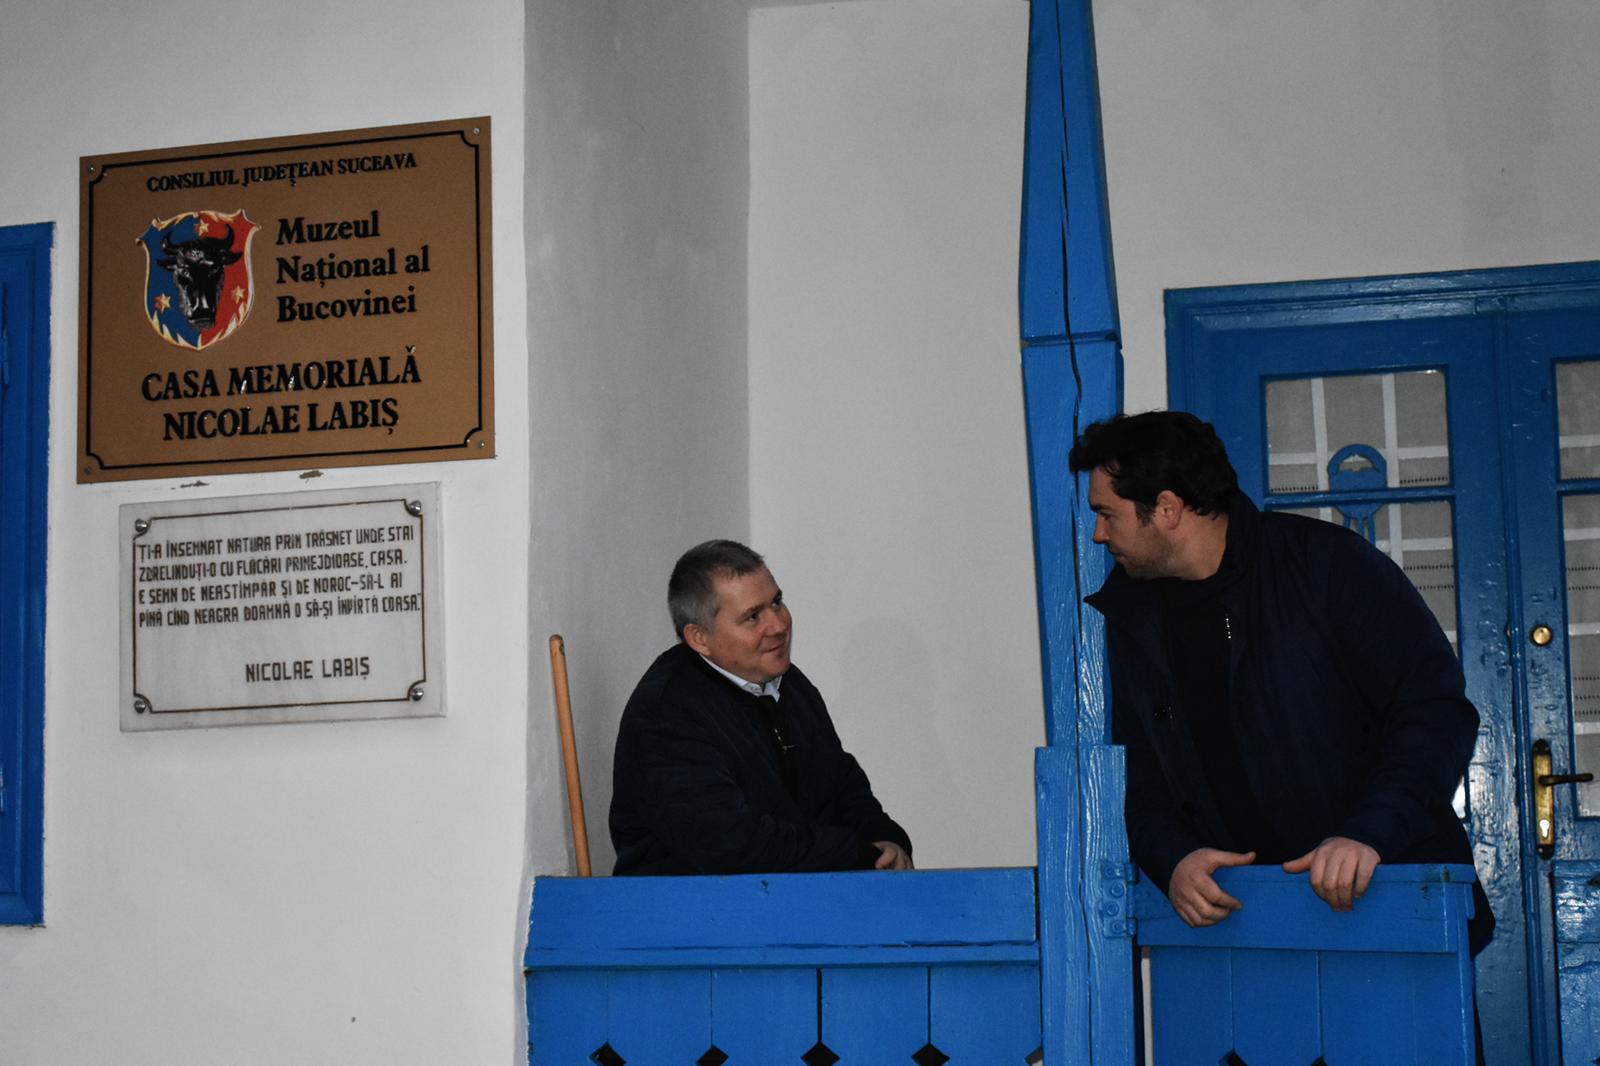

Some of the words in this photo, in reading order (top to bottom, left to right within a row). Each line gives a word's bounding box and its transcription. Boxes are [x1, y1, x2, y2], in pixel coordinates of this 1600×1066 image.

[147, 170, 239, 192] CONSILIUL
[242, 160, 334, 187] JUDEȚEAN
[337, 152, 416, 175] SUCEAVA
[275, 210, 380, 246] Muzeul
[275, 248, 397, 287] Național
[406, 245, 430, 274] al
[276, 286, 417, 323] Bucovinei
[141, 368, 219, 402] CASA
[227, 345, 421, 395] MEMORIALĂ
[163, 405, 300, 442] NICOLAE
[307, 398, 399, 436] LABIȘ
[227, 535, 271, 554] NATURA
[356, 527, 385, 544] UNDE
[388, 525, 414, 542] STAI
[220, 561, 234, 577] CU
[138, 589, 145, 605] E
[149, 587, 178, 605] SEMN
[181, 586, 196, 602] DE
[296, 578, 310, 595] DE
[390, 571, 403, 589] AI
[194, 606, 239, 624] NEAGRA
[294, 602, 302, 618] O
[245, 661, 313, 683] NICOLAE
[322, 656, 370, 680] LABIȘ
